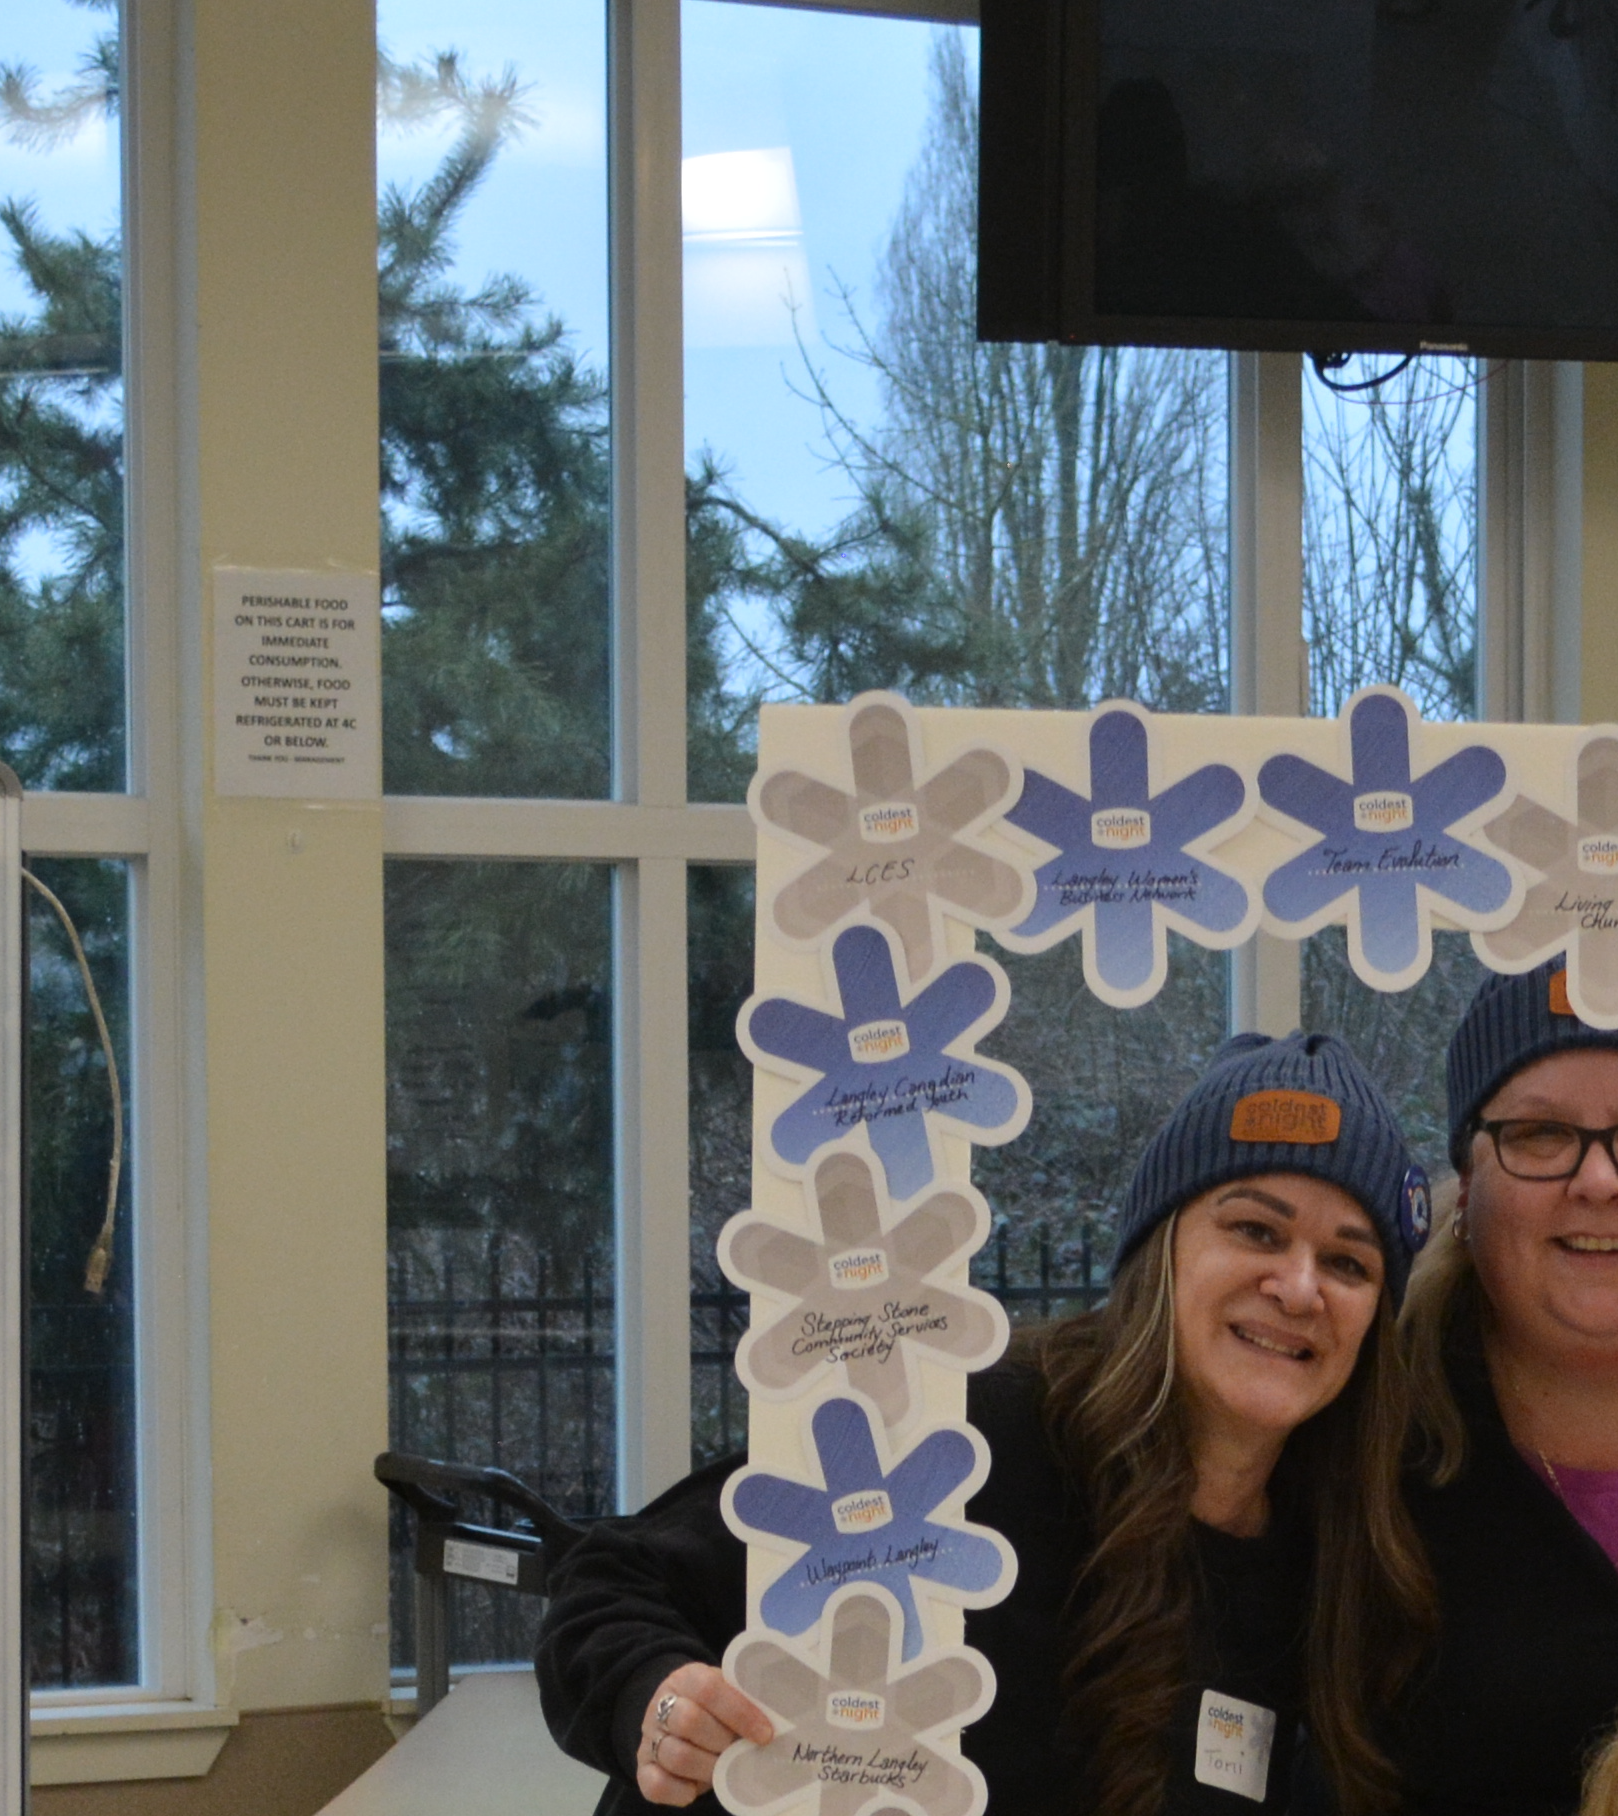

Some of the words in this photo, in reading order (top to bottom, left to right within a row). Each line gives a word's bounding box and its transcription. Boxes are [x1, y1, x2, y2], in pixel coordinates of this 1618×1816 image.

[242, 596, 311, 609] PERISHABLE
[314, 599, 348, 611] FOOD
[234, 615, 253, 626] ON
[257, 616, 282, 628] THIS
[286, 617, 315, 629] CART
[319, 618, 329, 629] IS
[332, 619, 355, 631] FOR
[262, 636, 330, 649] IMMEDIATE
[249, 655, 342, 669] CONSUMPTION.
[241, 676, 314, 691] OTHERWISE,
[316, 679, 351, 691] FOOD
[254, 696, 288, 708] MUST
[292, 697, 306, 709] BE
[310, 698, 338, 709] KEPT
[235, 715, 322, 729] REFRIGERATED
[326, 718, 338, 729] AT
[342, 718, 357, 730] 4C
[264, 735, 281, 747] OR
[285, 736, 329, 749] BELOW.
[1359, 798, 1406, 810] coldest
[864, 808, 912, 822] coldest
[1097, 815, 1144, 827] coldest
[1368, 808, 1407, 824] night
[874, 817, 914, 834] night
[1106, 825, 1145, 841] night
[846, 858, 915, 885] LCES
[1554, 891, 1614, 916] Living
[854, 1026, 901, 1043] coldest
[864, 1035, 903, 1053] night
[834, 1254, 880, 1271] coldest
[844, 1262, 883, 1280] night
[802, 1312, 872, 1338] Stepping
[878, 1302, 929, 1322] Stone
[792, 1327, 883, 1355] Community
[887, 1316, 948, 1338] Services
[826, 1340, 895, 1365] Society
[837, 1495, 884, 1515] coldest
[849, 1504, 887, 1523] night
[832, 1697, 879, 1709] coldest
[840, 1706, 879, 1722] night
[1208, 1706, 1244, 1726] coldest
[1213, 1718, 1244, 1739] night
[793, 1743, 863, 1766] Northern
[868, 1748, 928, 1783] Langley
[818, 1766, 907, 1789] Starbucks
